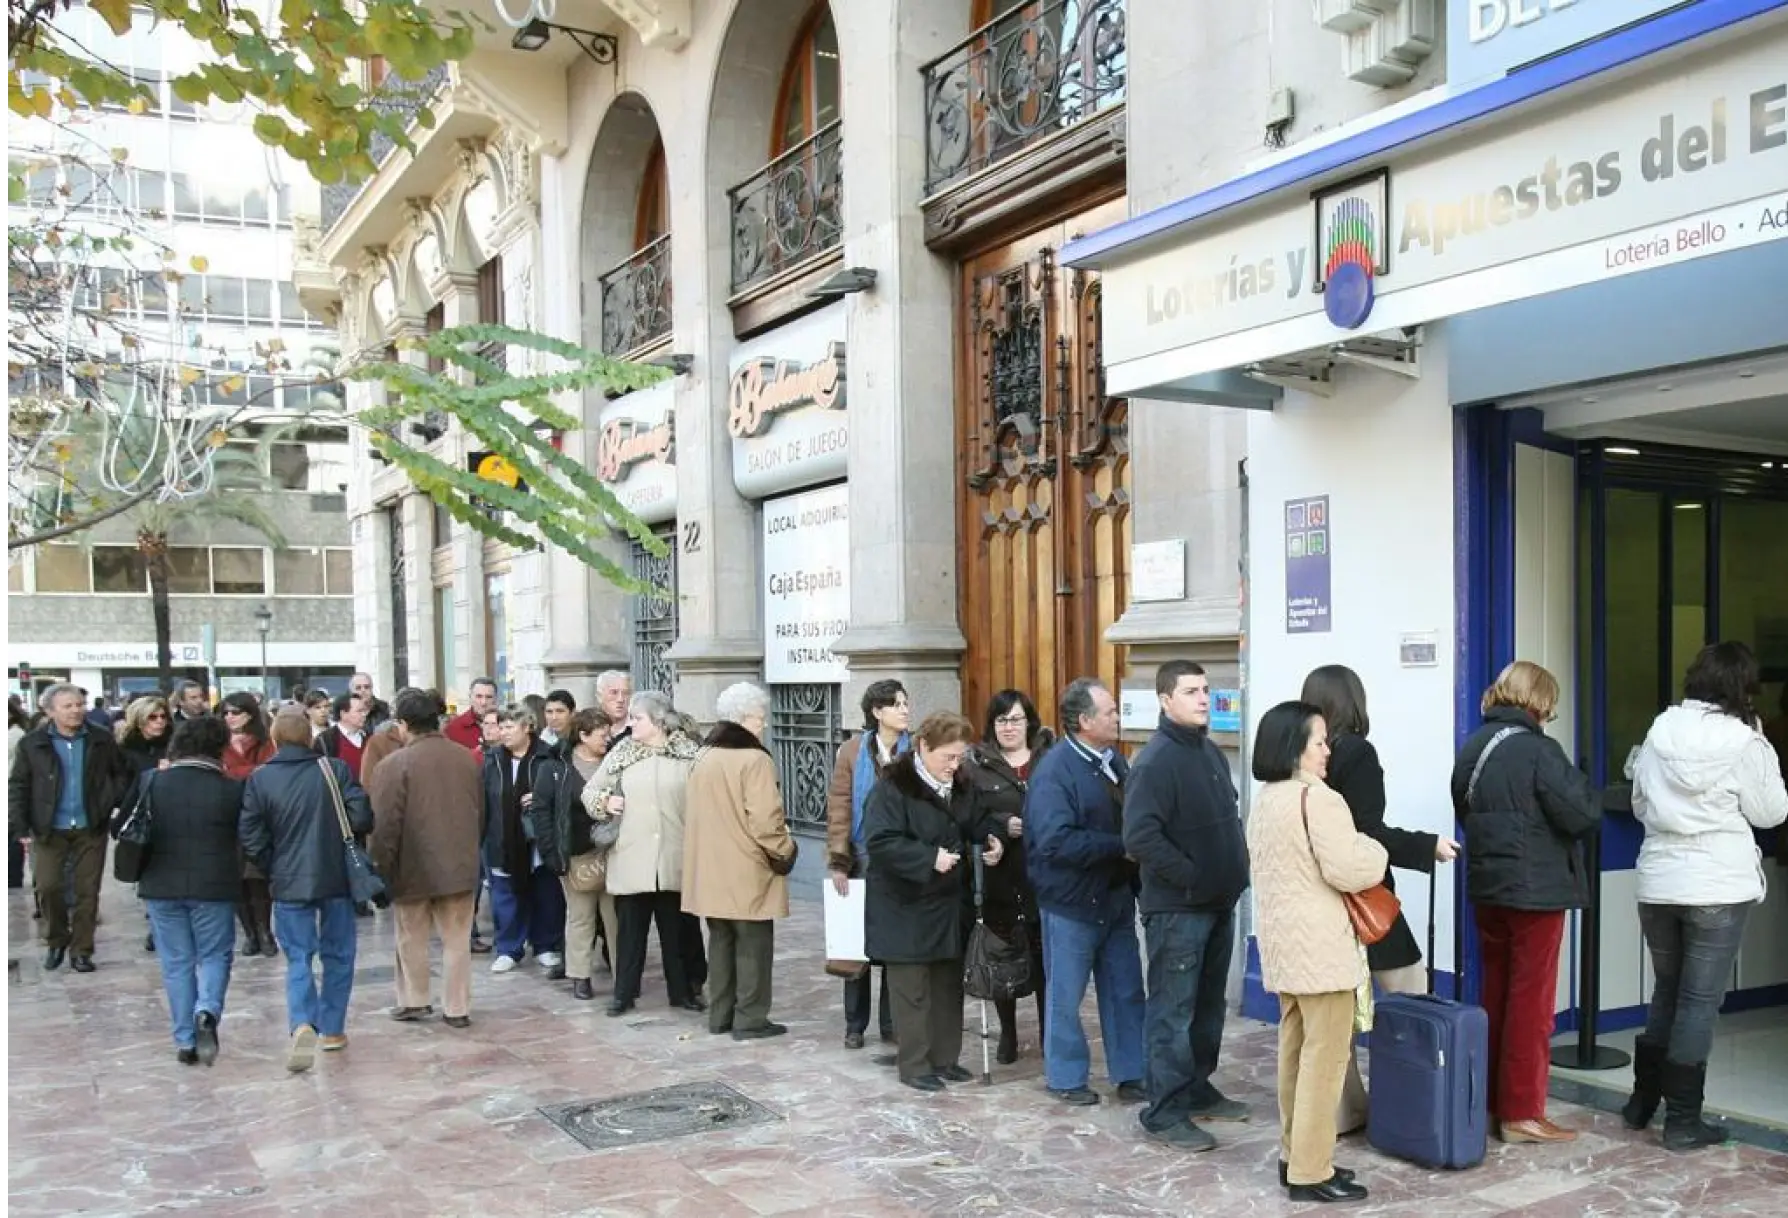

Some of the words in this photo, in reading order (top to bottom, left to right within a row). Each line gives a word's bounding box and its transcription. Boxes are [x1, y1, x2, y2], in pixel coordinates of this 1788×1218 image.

[1146, 254, 1275, 326] Lotrías
[1286, 247, 1307, 299] y
[1399, 151, 1622, 256] Apuestas
[1641, 97, 1727, 182] del
[1749, 83, 1787, 154] E
[1676, 220, 1726, 252] Bello
[787, 440, 802, 463] DE
[767, 515, 797, 535] LOCAL
[776, 623, 800, 639] PARA
[802, 622, 820, 638] SUS
[77, 650, 140, 662] Deutsche
[786, 646, 843, 664] INSTALAC
